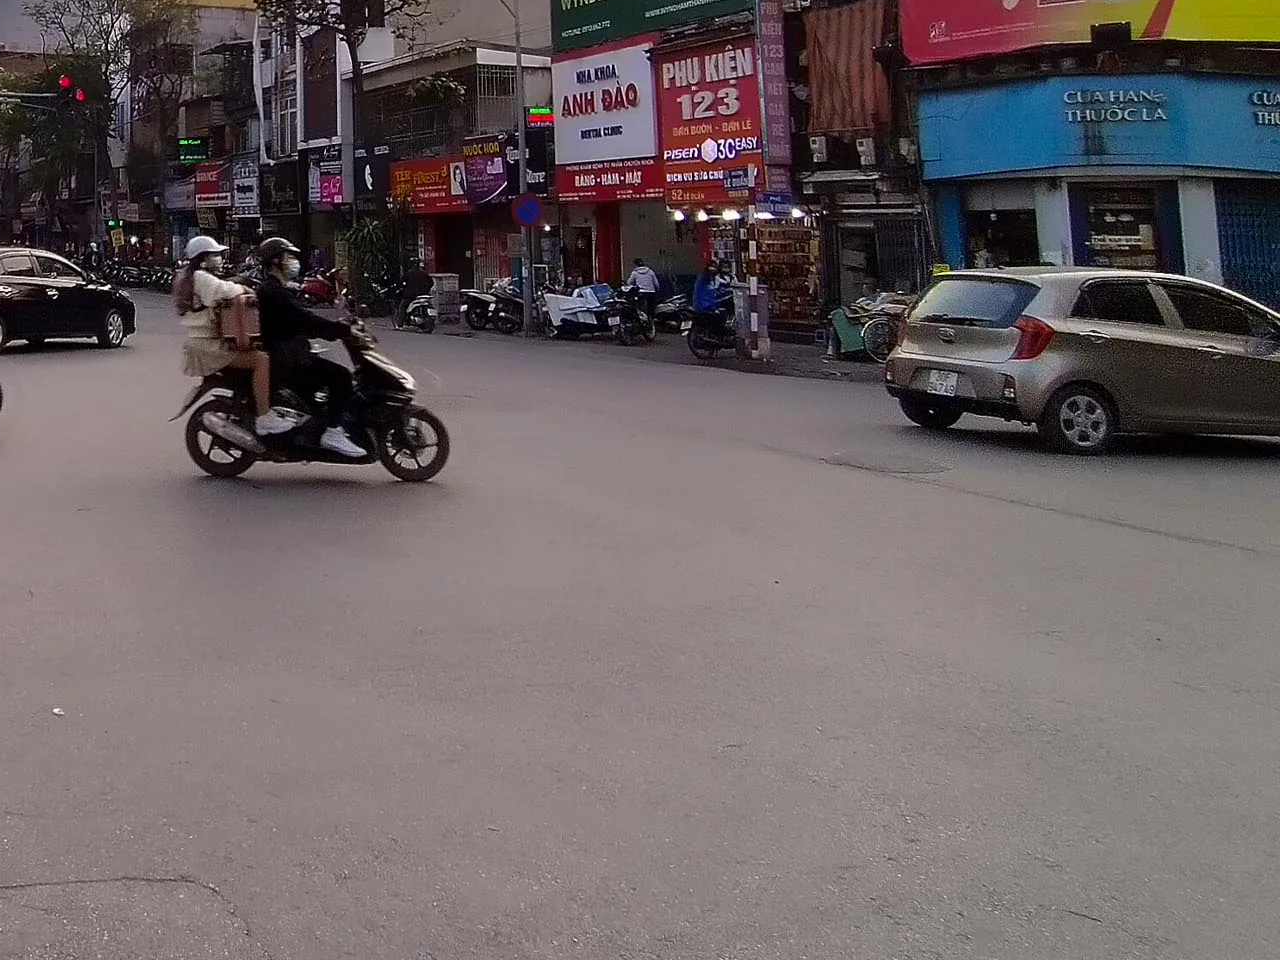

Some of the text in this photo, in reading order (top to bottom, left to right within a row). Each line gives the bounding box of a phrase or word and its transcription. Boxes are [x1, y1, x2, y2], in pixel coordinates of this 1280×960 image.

[763, 45, 784, 58] 123
[576, 64, 619, 84] NHA KHOA
[663, 45, 754, 91] PHỤ KIỆN
[561, 91, 597, 118] ANH
[601, 80, 640, 112] ĐÀO
[676, 87, 740, 120] 123
[735, 137, 757, 150] EASY
[601, 171, 620, 185] HÀM
[671, 189, 682, 200] 52
